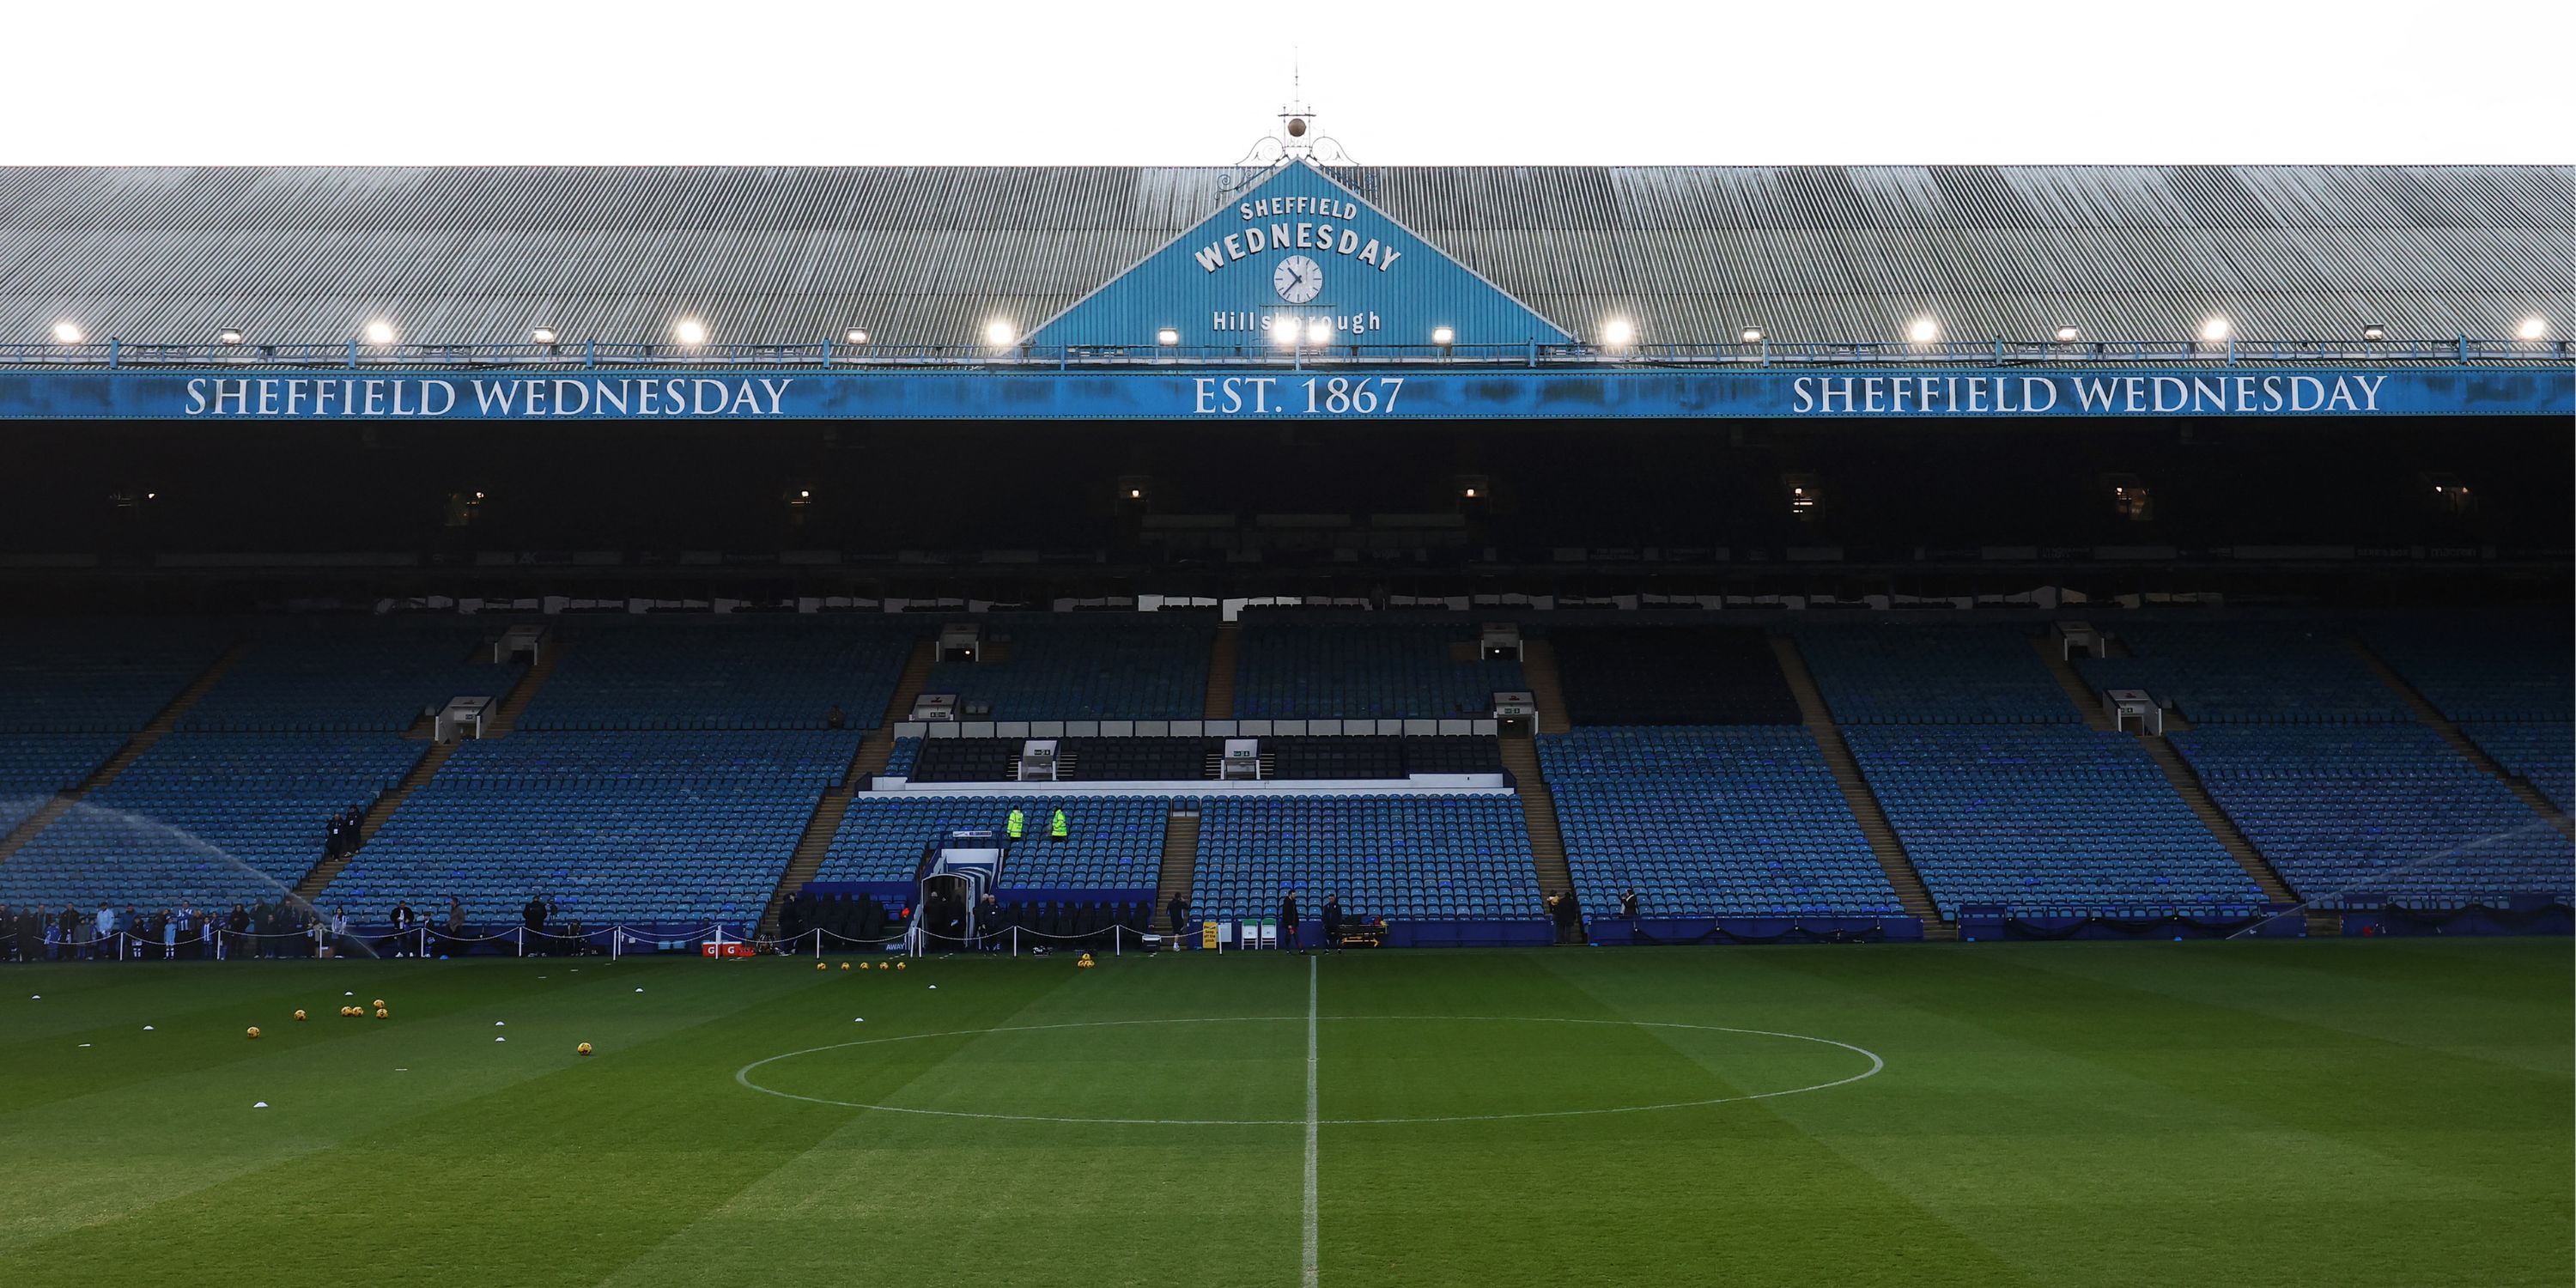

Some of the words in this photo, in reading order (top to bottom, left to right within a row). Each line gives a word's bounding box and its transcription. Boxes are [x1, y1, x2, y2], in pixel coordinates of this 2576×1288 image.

[1240, 197, 1358, 220] SHEFFIELD
[1194, 222, 1401, 274] WEDNESDAY
[185, 378, 456, 416] SHEFFIELD
[470, 378, 794, 416] WEDNESDAY
[1192, 377, 1284, 414] EST.
[1301, 377, 1405, 414] 1867
[1793, 376, 2057, 413] SHEFFIELD
[2071, 375, 2388, 412] WEDNESDAY
